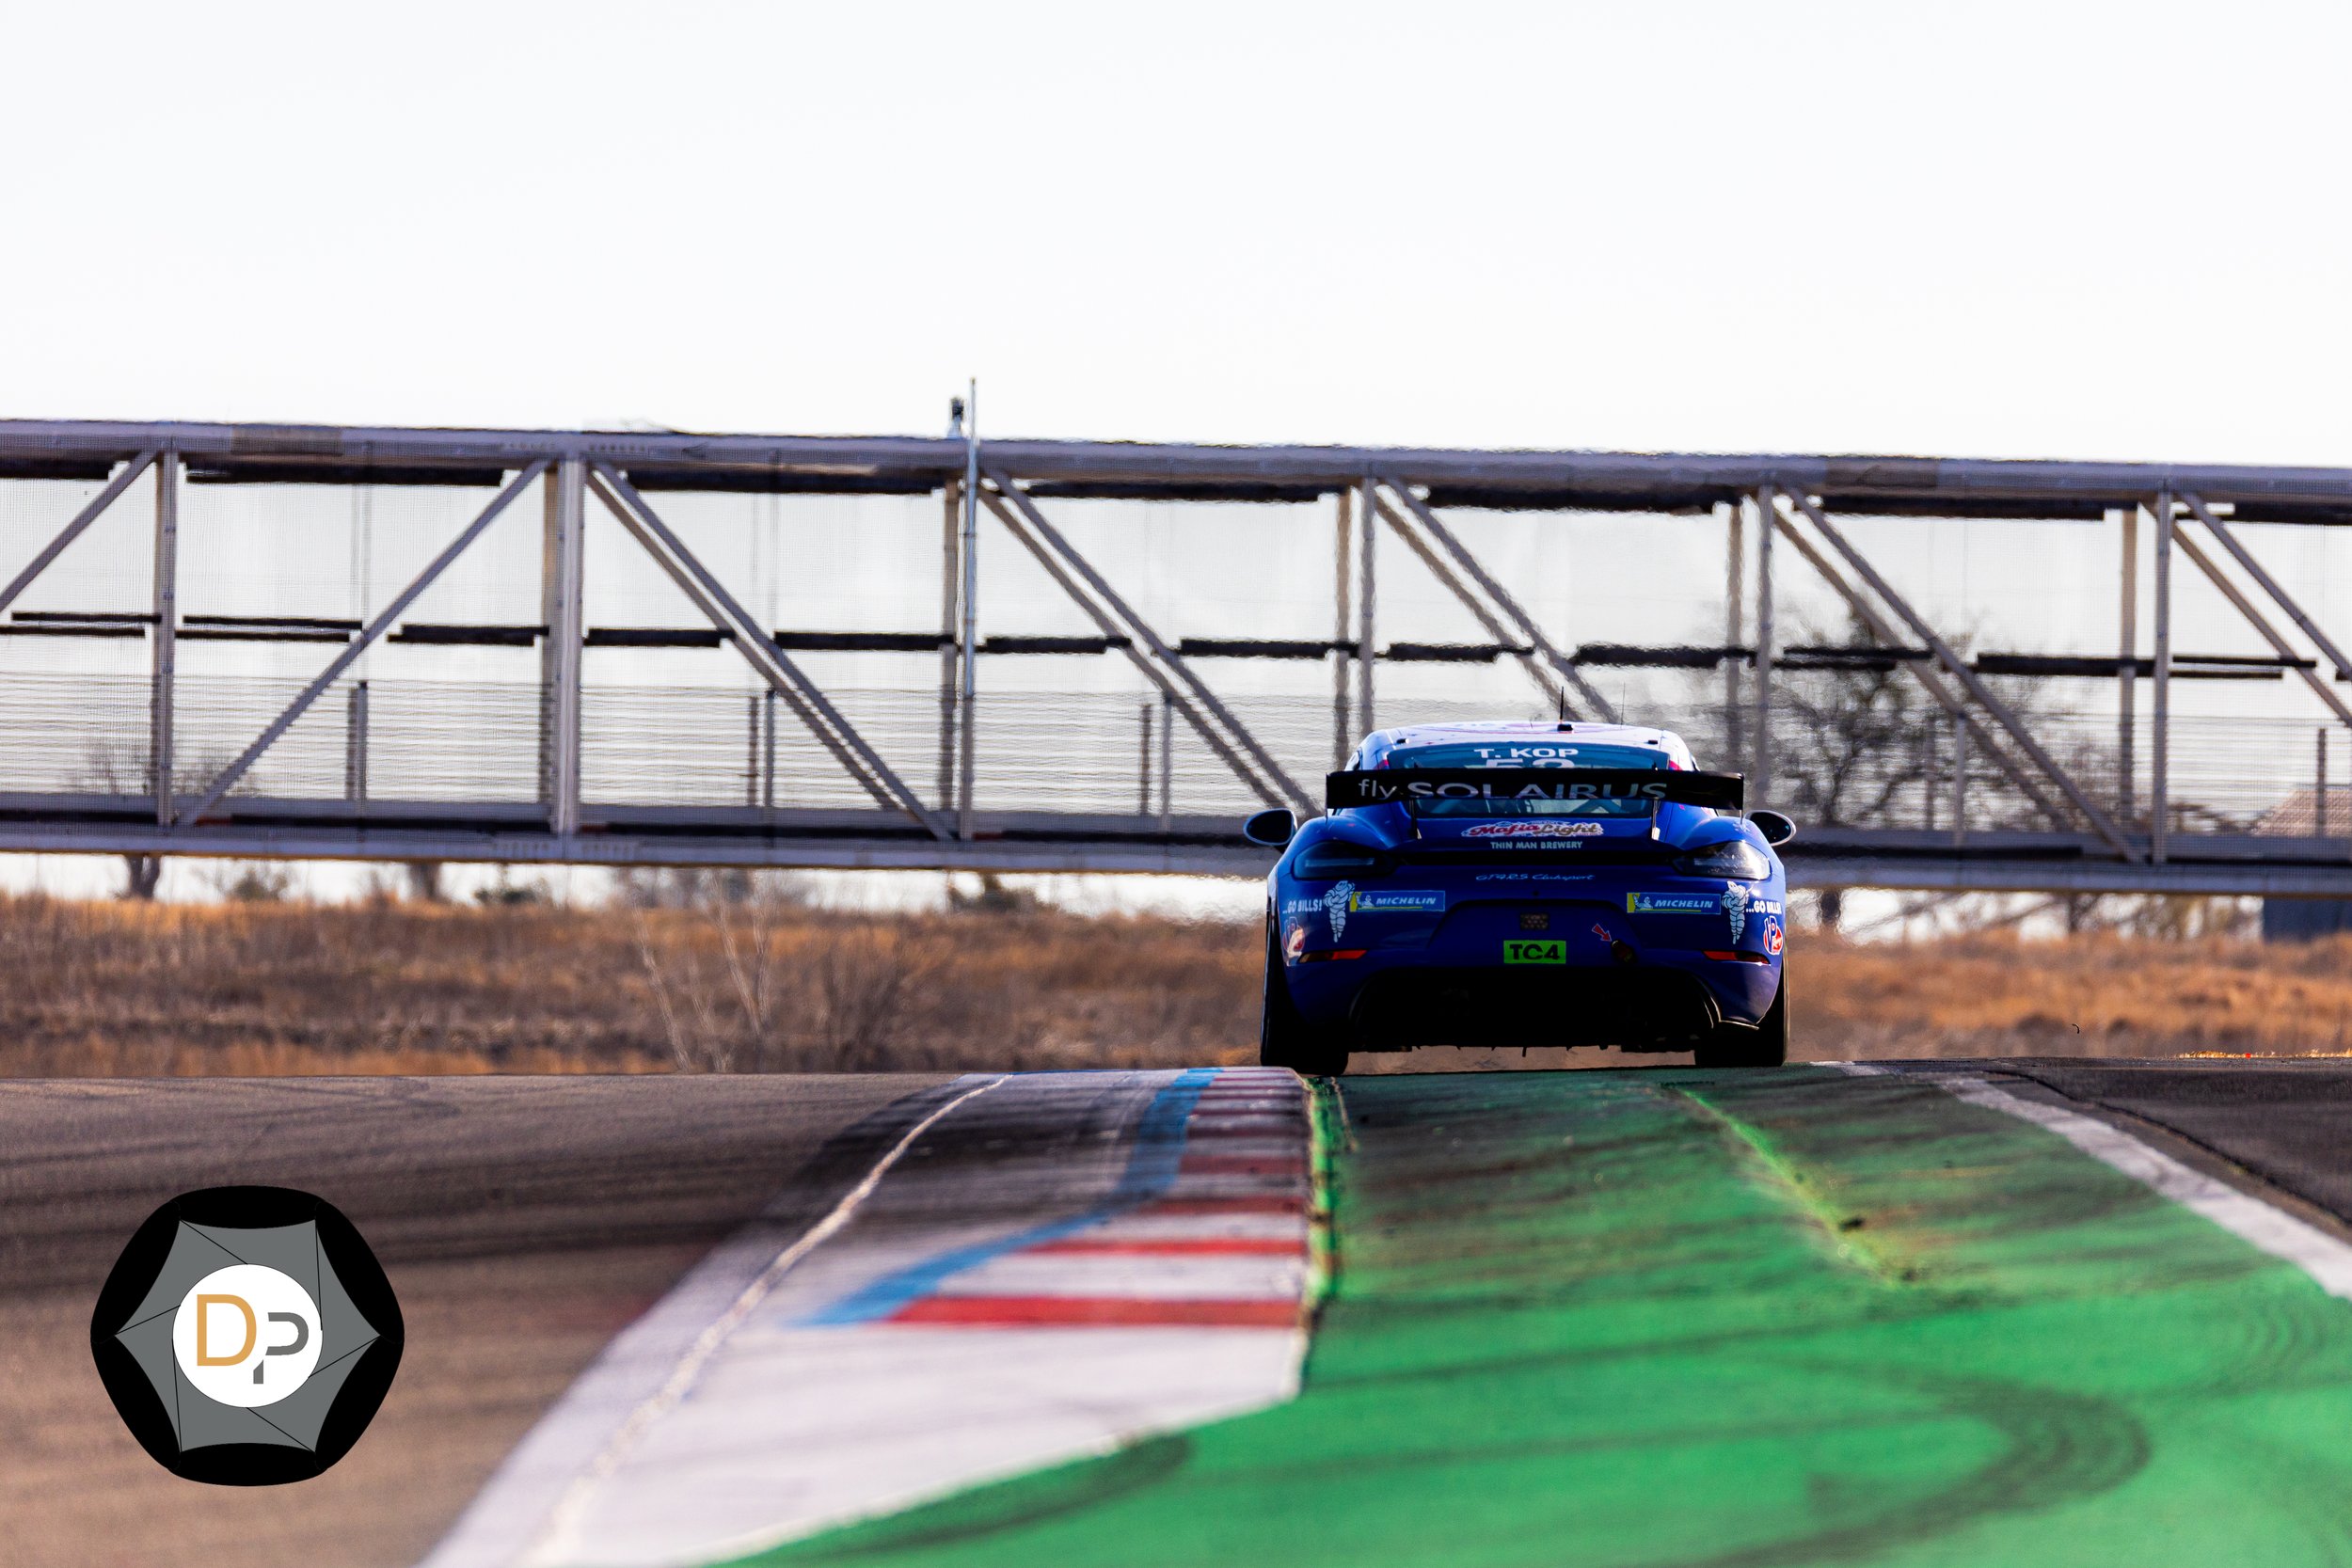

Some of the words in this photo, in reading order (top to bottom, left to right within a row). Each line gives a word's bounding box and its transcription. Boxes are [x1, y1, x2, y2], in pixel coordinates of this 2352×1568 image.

[1473, 748, 1502, 759] T.
[1510, 748, 1579, 758] KOP
[1358, 779, 1398, 799] fly
[1407, 782, 1668, 800] SOLAIRUS
[1490, 841, 1513, 849] THIN
[1516, 841, 1537, 849] MAN
[1540, 841, 1583, 849] BREWERY
[1297, 898, 1323, 912] BILLS!
[1375, 896, 1437, 905] MICHELIN
[1654, 899, 1713, 909] MICHELIN
[1509, 943, 1560, 960] TC4
